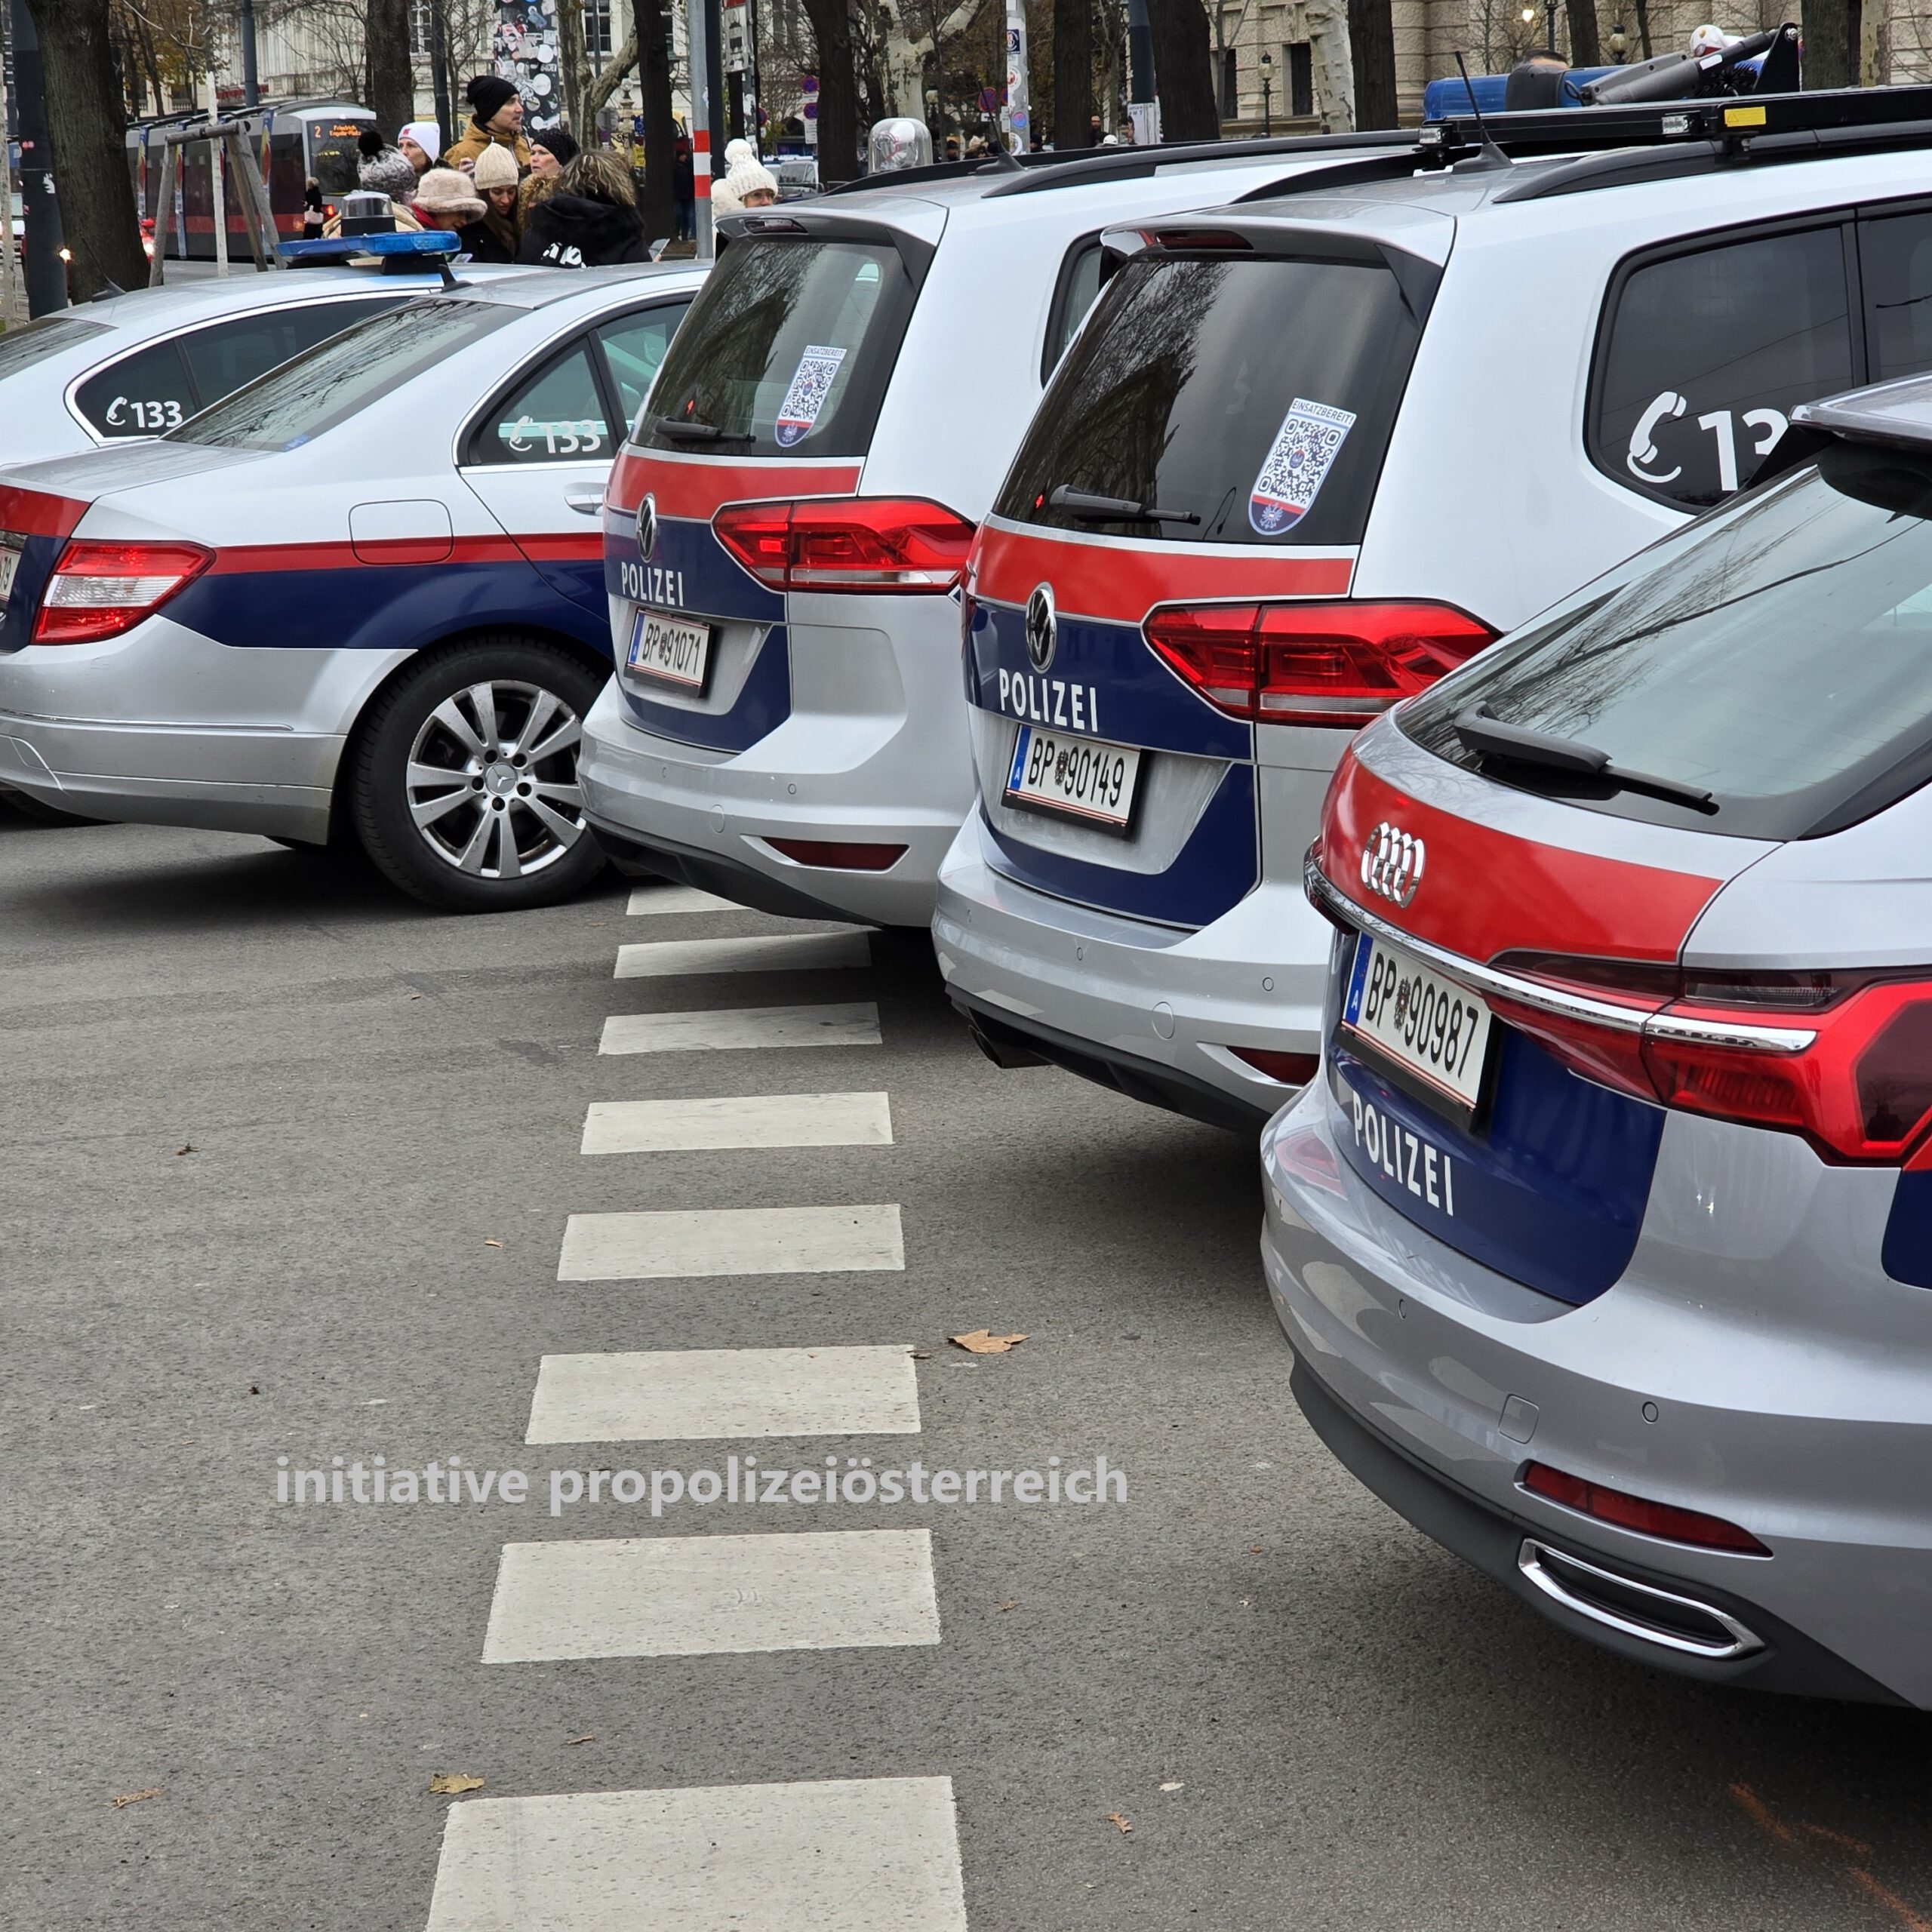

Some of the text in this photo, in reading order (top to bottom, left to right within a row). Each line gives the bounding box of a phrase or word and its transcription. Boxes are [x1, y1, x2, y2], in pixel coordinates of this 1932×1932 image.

[314, 125, 321, 138] 2
[130, 401, 183, 428] 133
[1292, 400, 1355, 425] EINSATZBEREIT!
[538, 420, 601, 454] 133
[621, 561, 684, 606] POLIZEI
[642, 623, 701, 675] BP 91071
[998, 668, 1098, 732] POLIZEI
[1028, 737, 1124, 808] BP 90149
[1351, 989, 1359, 1011] A
[1365, 952, 1478, 1079] BP 90987
[1353, 1090, 1454, 1217] POLIZEI
